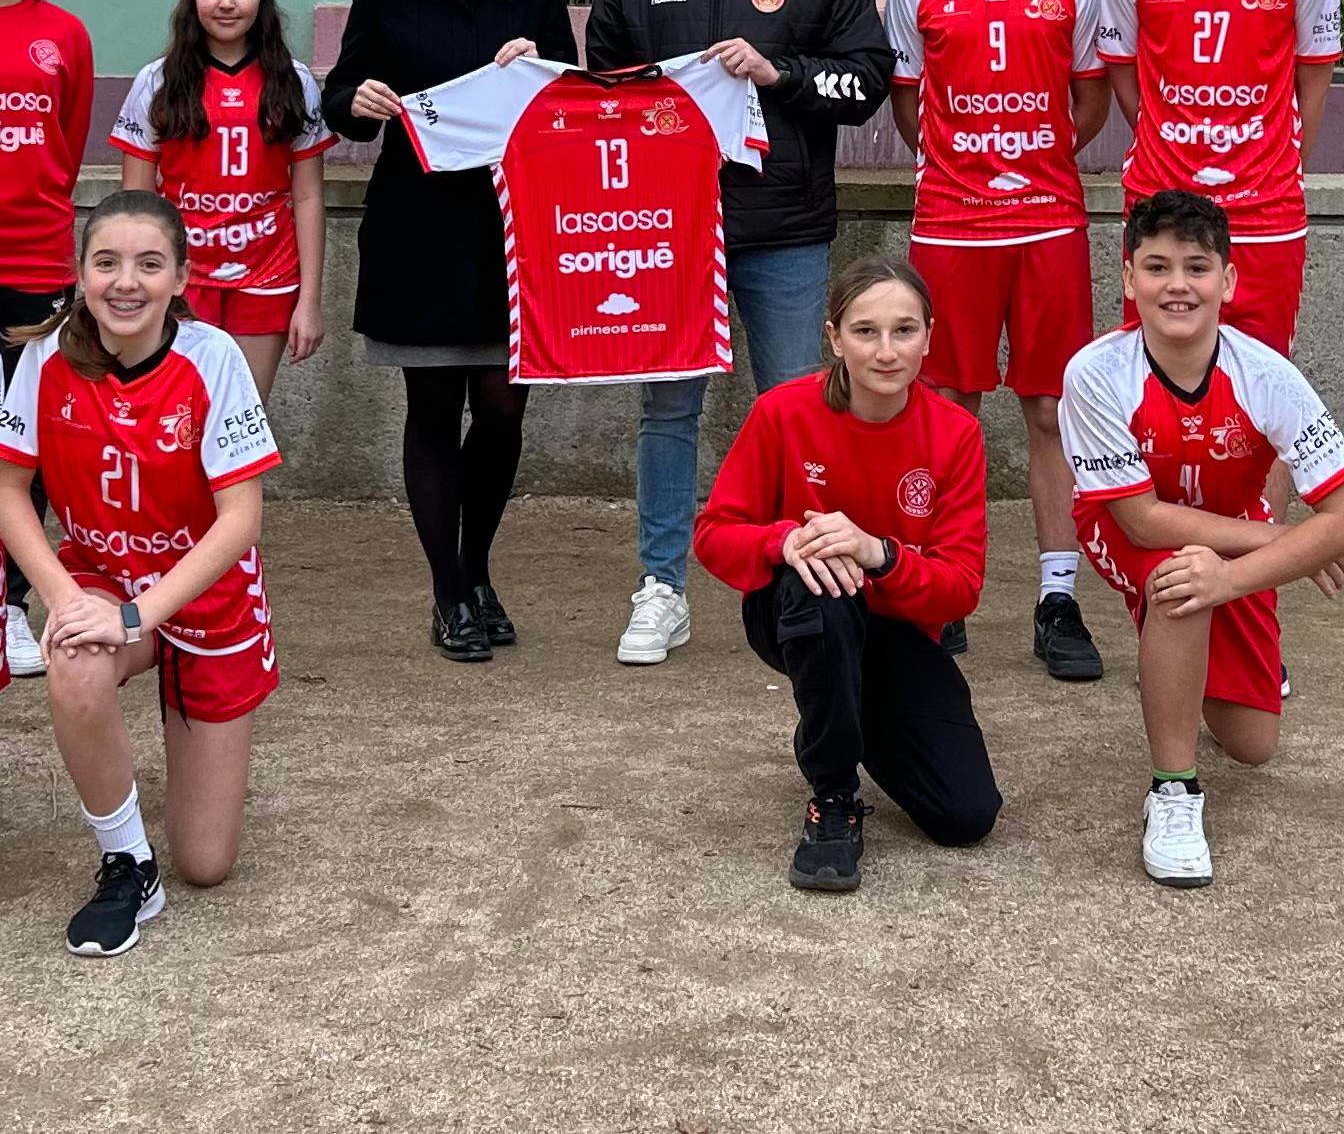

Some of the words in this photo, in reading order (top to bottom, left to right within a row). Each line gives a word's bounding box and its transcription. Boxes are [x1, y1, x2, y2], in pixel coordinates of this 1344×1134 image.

[989, 20, 1006, 72] 9
[1193, 11, 1231, 63] 27
[947, 85, 1050, 115] lasaosa
[217, 126, 249, 177] 13
[595, 138, 630, 190] 13
[555, 205, 673, 235] lasaosa
[570, 325, 629, 339] pirineos
[632, 322, 667, 333] casa
[100, 444, 140, 512] 21
[65, 506, 196, 557] lasaosa
